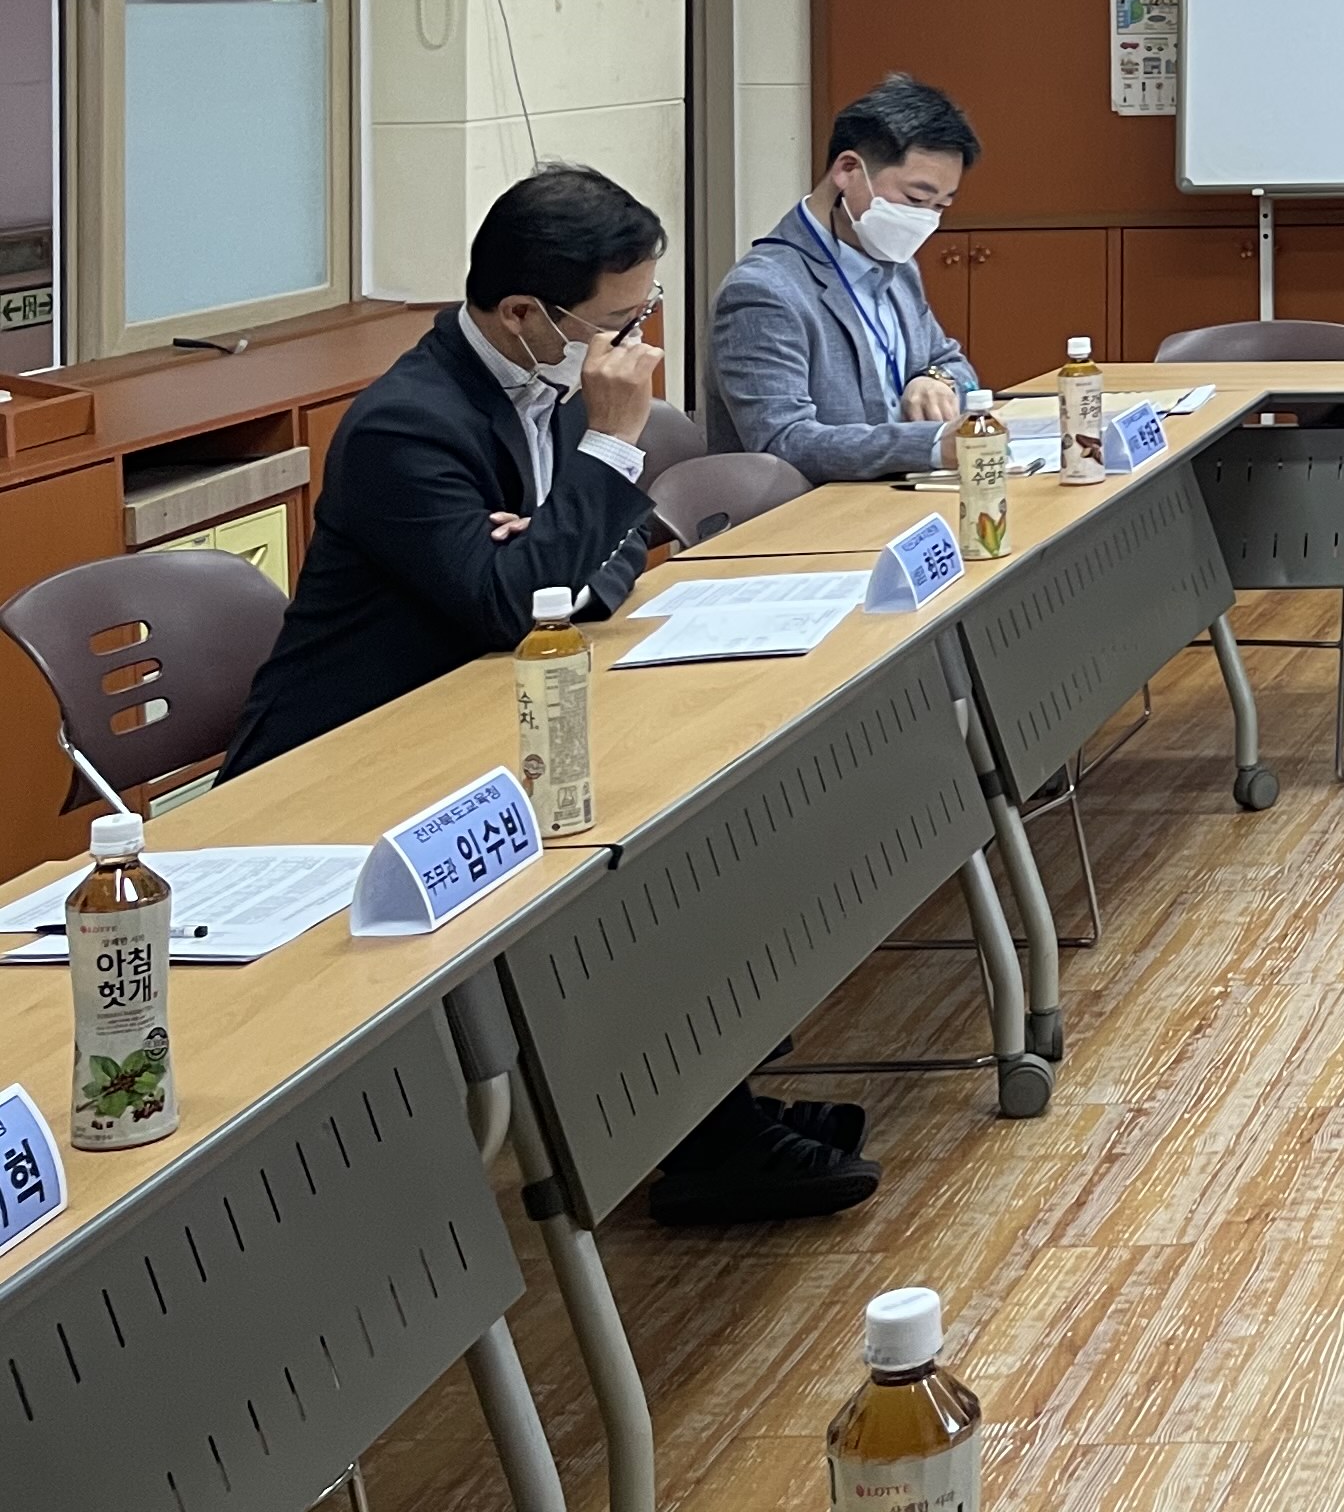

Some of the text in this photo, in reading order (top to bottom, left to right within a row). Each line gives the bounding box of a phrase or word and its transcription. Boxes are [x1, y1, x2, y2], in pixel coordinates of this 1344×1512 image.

[413, 784, 501, 844] 전라북도교육청
[423, 801, 529, 897] 주무관 임수빈
[97, 943, 152, 979] 아침
[97, 974, 152, 1010] 헛개
